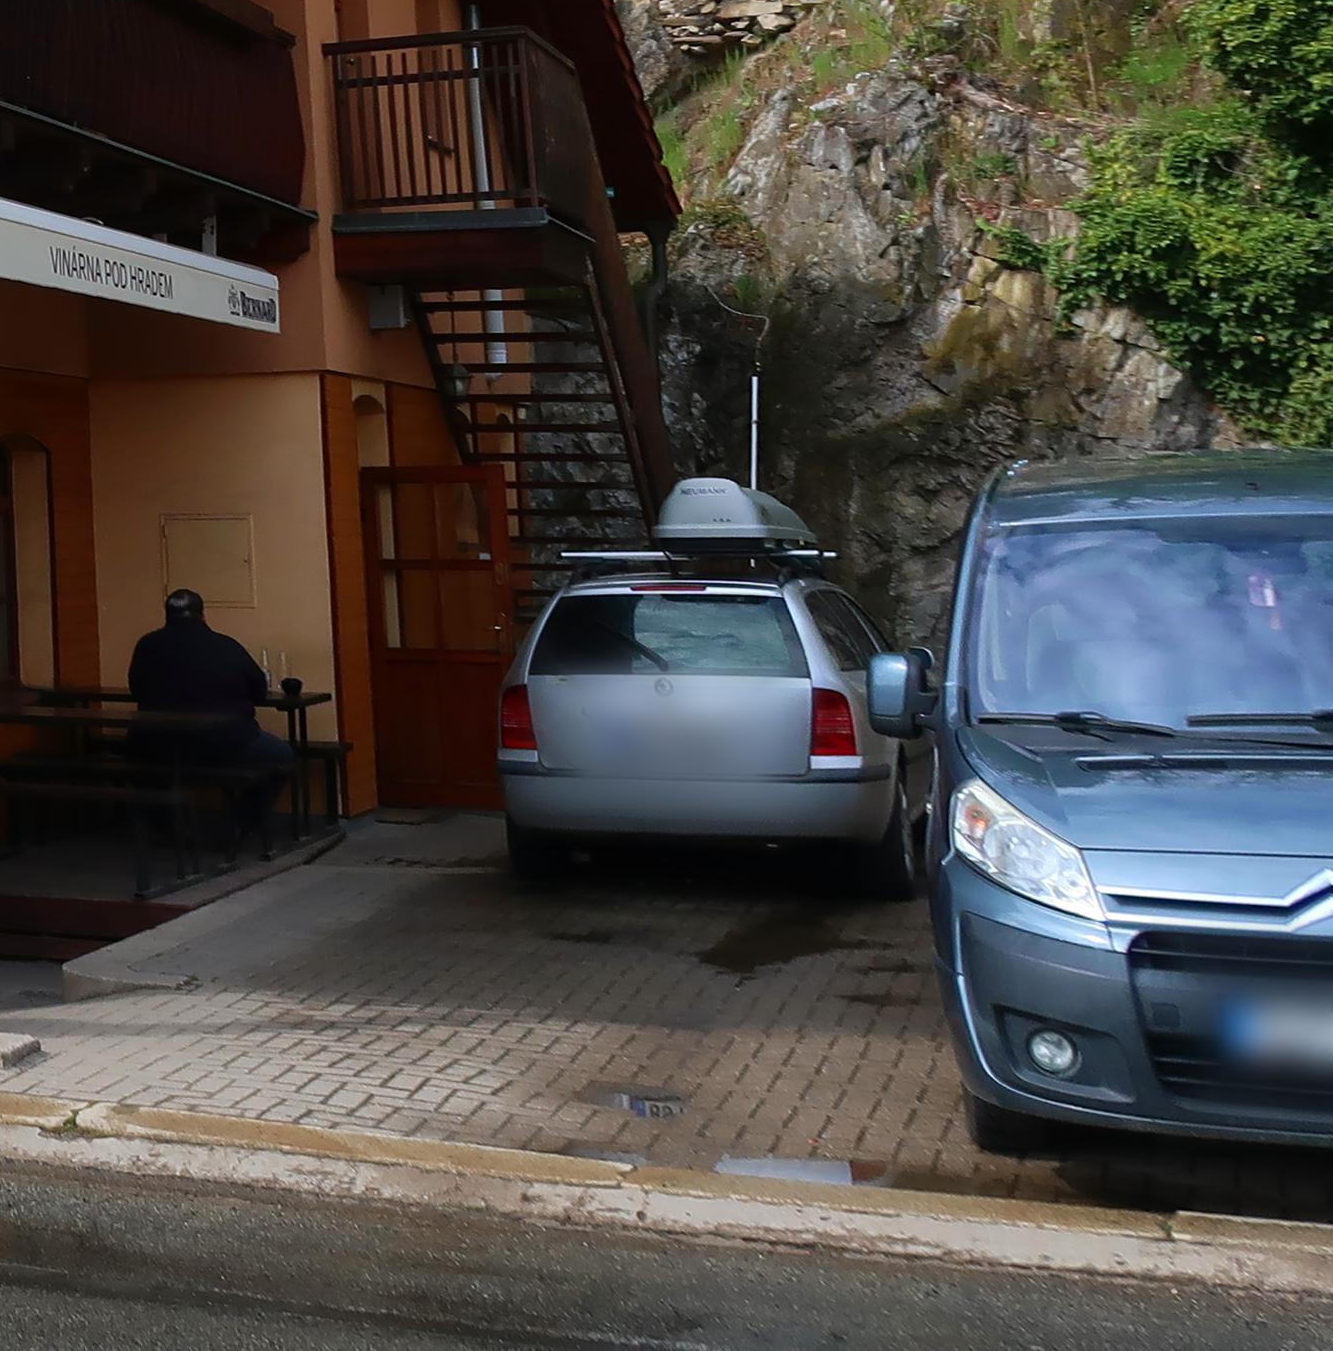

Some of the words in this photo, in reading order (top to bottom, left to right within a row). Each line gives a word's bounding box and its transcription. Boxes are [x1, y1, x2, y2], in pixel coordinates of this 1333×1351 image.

[49, 245, 103, 284] VINÁRNA
[104, 259, 128, 289] POD
[129, 265, 173, 299] HRADEM
[239, 290, 277, 323] BERNARD
